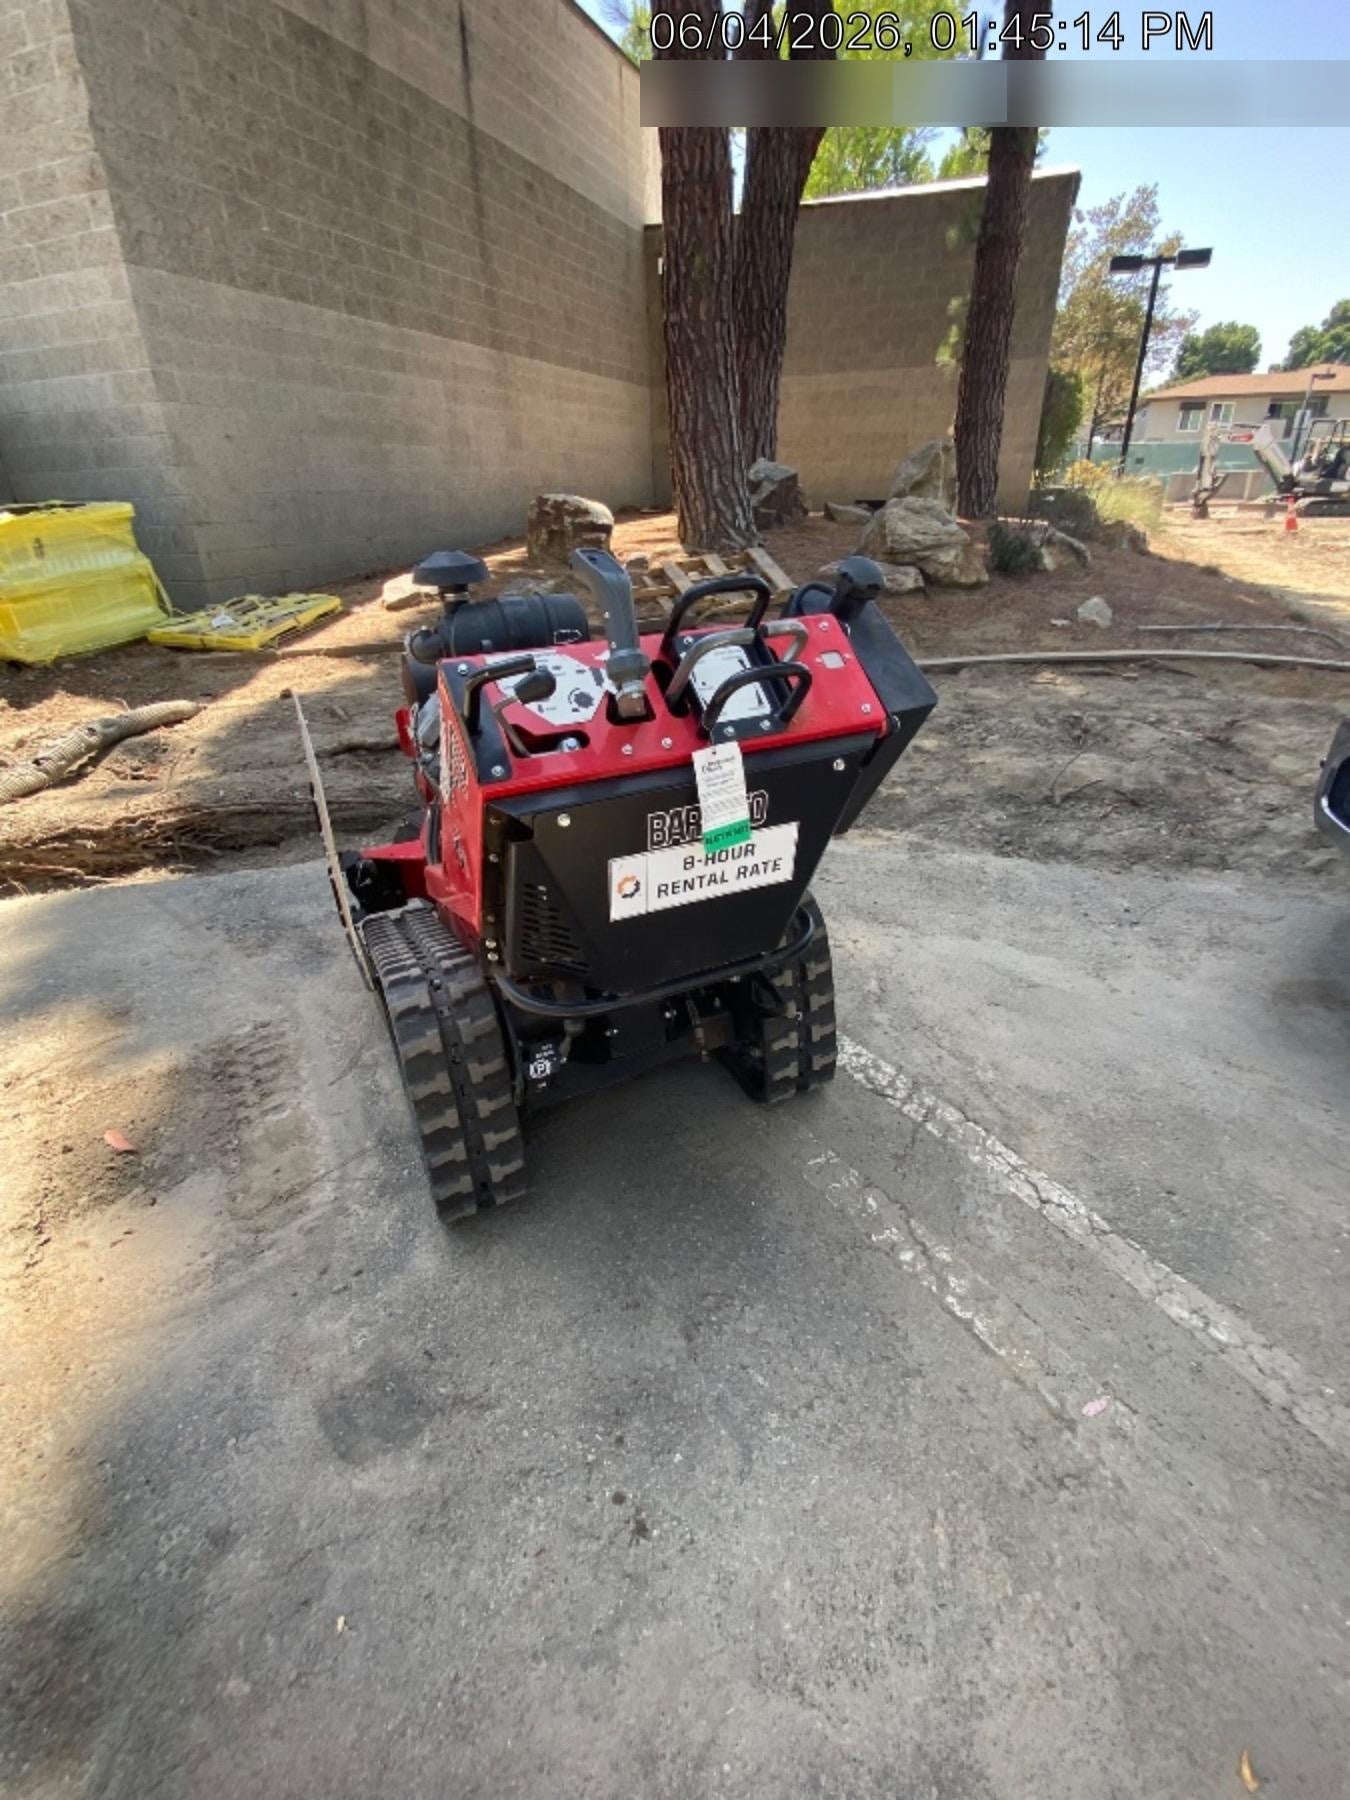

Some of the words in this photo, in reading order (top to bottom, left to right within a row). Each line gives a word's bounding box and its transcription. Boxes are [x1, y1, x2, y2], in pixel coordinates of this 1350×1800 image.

[648, 790, 768, 850] BARO
[683, 843, 755, 870] 8-HOUR
[657, 871, 729, 898] RENTAL
[736, 857, 783, 880] RATE
